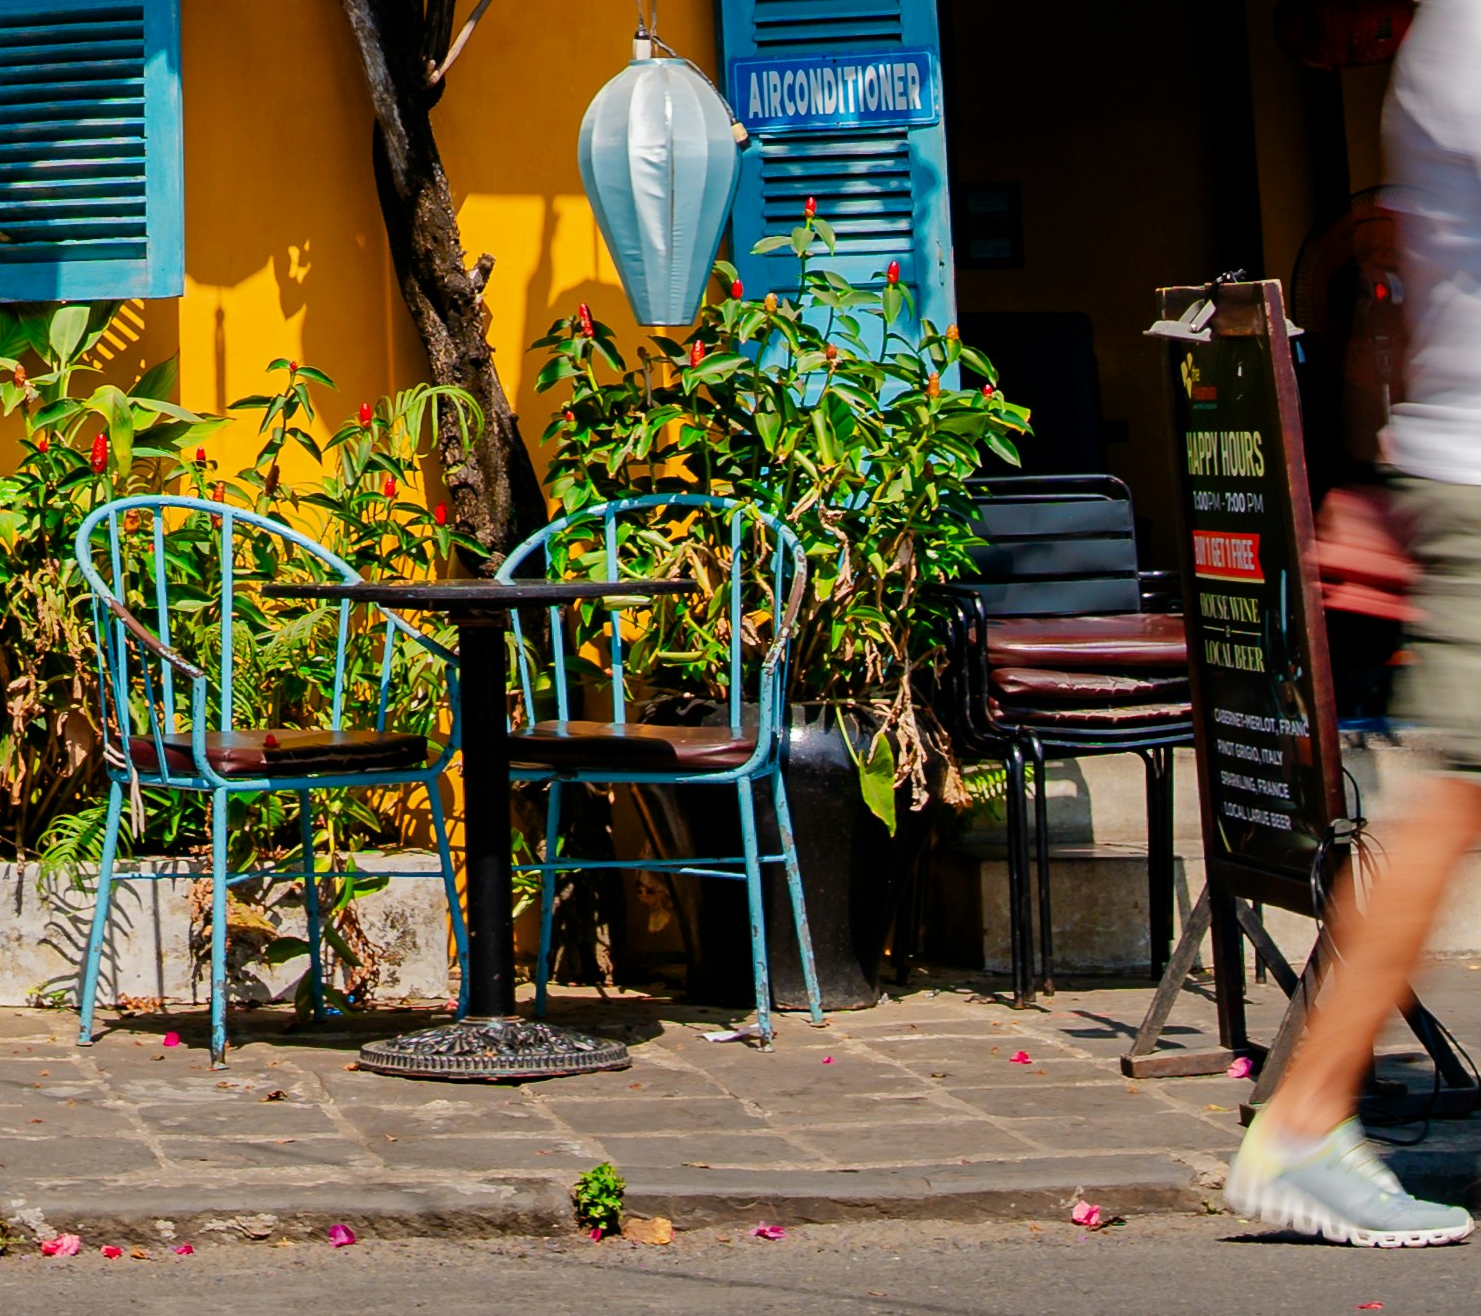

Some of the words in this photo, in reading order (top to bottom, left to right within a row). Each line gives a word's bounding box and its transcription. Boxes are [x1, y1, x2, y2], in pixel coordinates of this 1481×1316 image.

[1186, 431, 1218, 476] HAPPY
[1220, 431, 1265, 477] HOURS
[1231, 539, 1255, 570] FREE
[1229, 596, 1261, 623] WINE
[1234, 644, 1265, 672] BEER
[1279, 714, 1310, 737] FRANC
